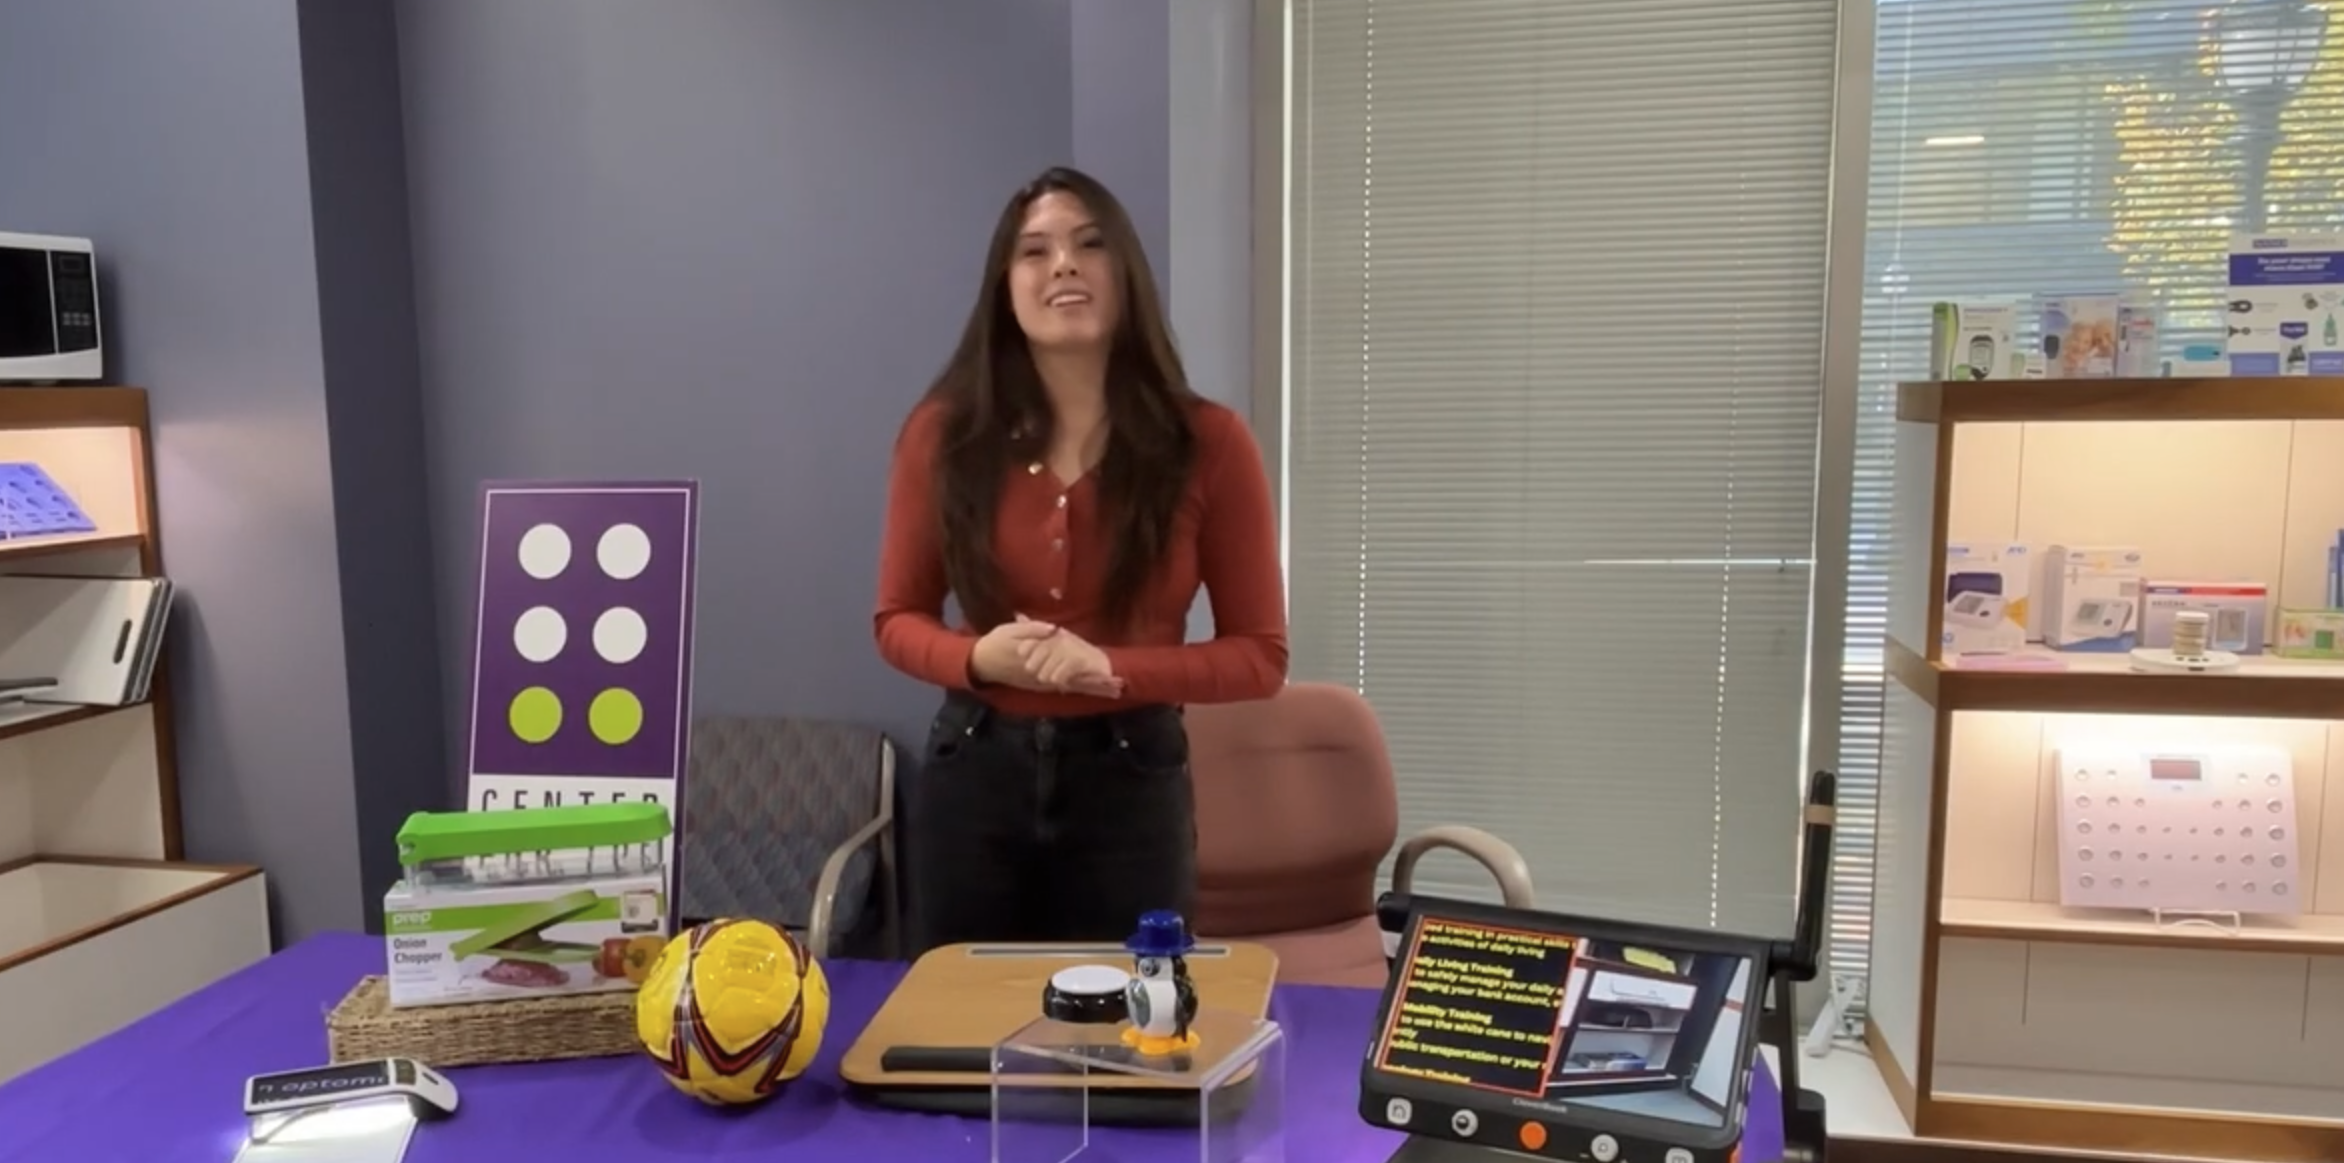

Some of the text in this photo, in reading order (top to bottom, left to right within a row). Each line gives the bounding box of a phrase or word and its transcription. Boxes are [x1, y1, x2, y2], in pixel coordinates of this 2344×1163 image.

[393, 911, 432, 925] prep
[394, 938, 427, 949] Onion
[1478, 940, 1489, 949] of
[1490, 942, 1515, 955] daily
[1517, 946, 1545, 959] living
[394, 952, 443, 965] Chopper
[1437, 958, 1469, 973] Living
[1471, 963, 1514, 978] Training
[1427, 969, 1458, 983] safely
[1459, 976, 1501, 988] manage
[1502, 980, 1527, 990] your
[1528, 982, 1556, 995] daily
[1450, 986, 1476, 996] your
[1449, 1007, 1493, 1025] Training
[1435, 1019, 1452, 1030] the
[1454, 1022, 1485, 1034] white
[1486, 1029, 1512, 1039] cane
[1513, 1031, 1525, 1041] to
[1420, 1043, 1498, 1063] transportation
[1500, 1055, 1512, 1065] or
[1513, 1058, 1541, 1069] your
